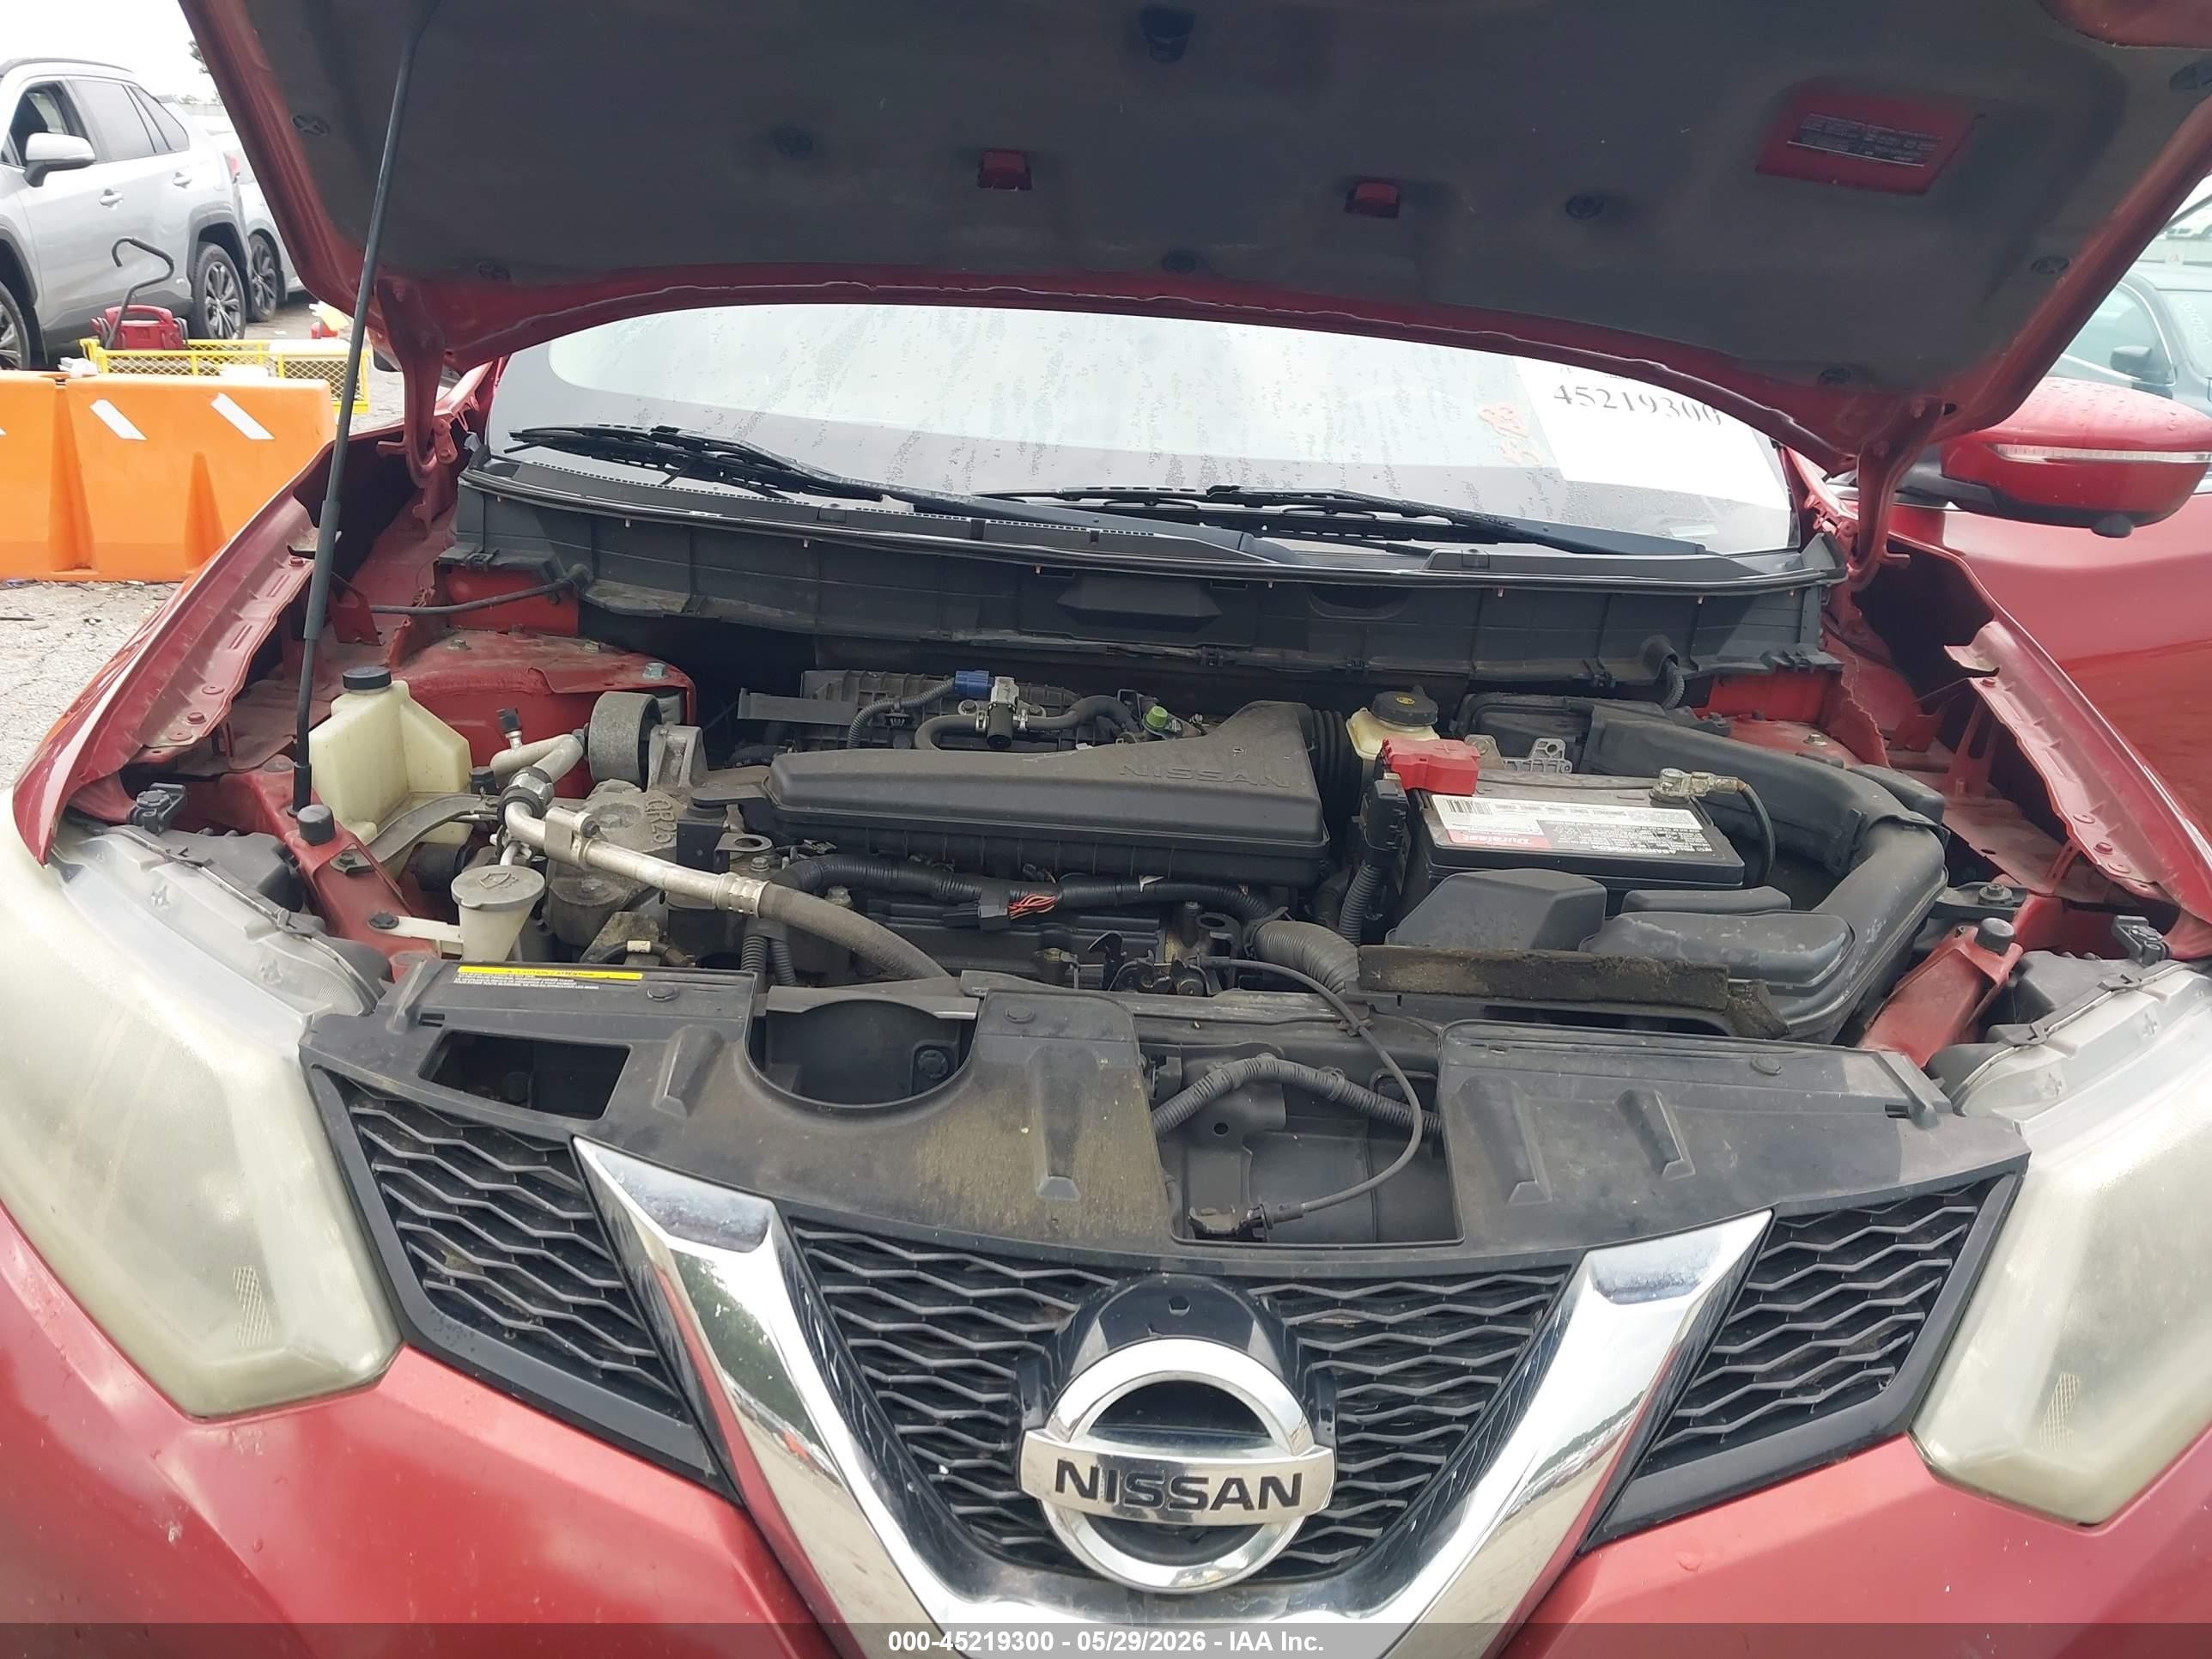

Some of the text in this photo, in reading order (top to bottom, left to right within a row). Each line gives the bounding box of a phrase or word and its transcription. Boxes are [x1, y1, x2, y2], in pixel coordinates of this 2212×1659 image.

[1119, 764, 1291, 789] NISSAN
[644, 799, 678, 844] QR25
[1054, 1458, 1303, 1511] NISSAN
